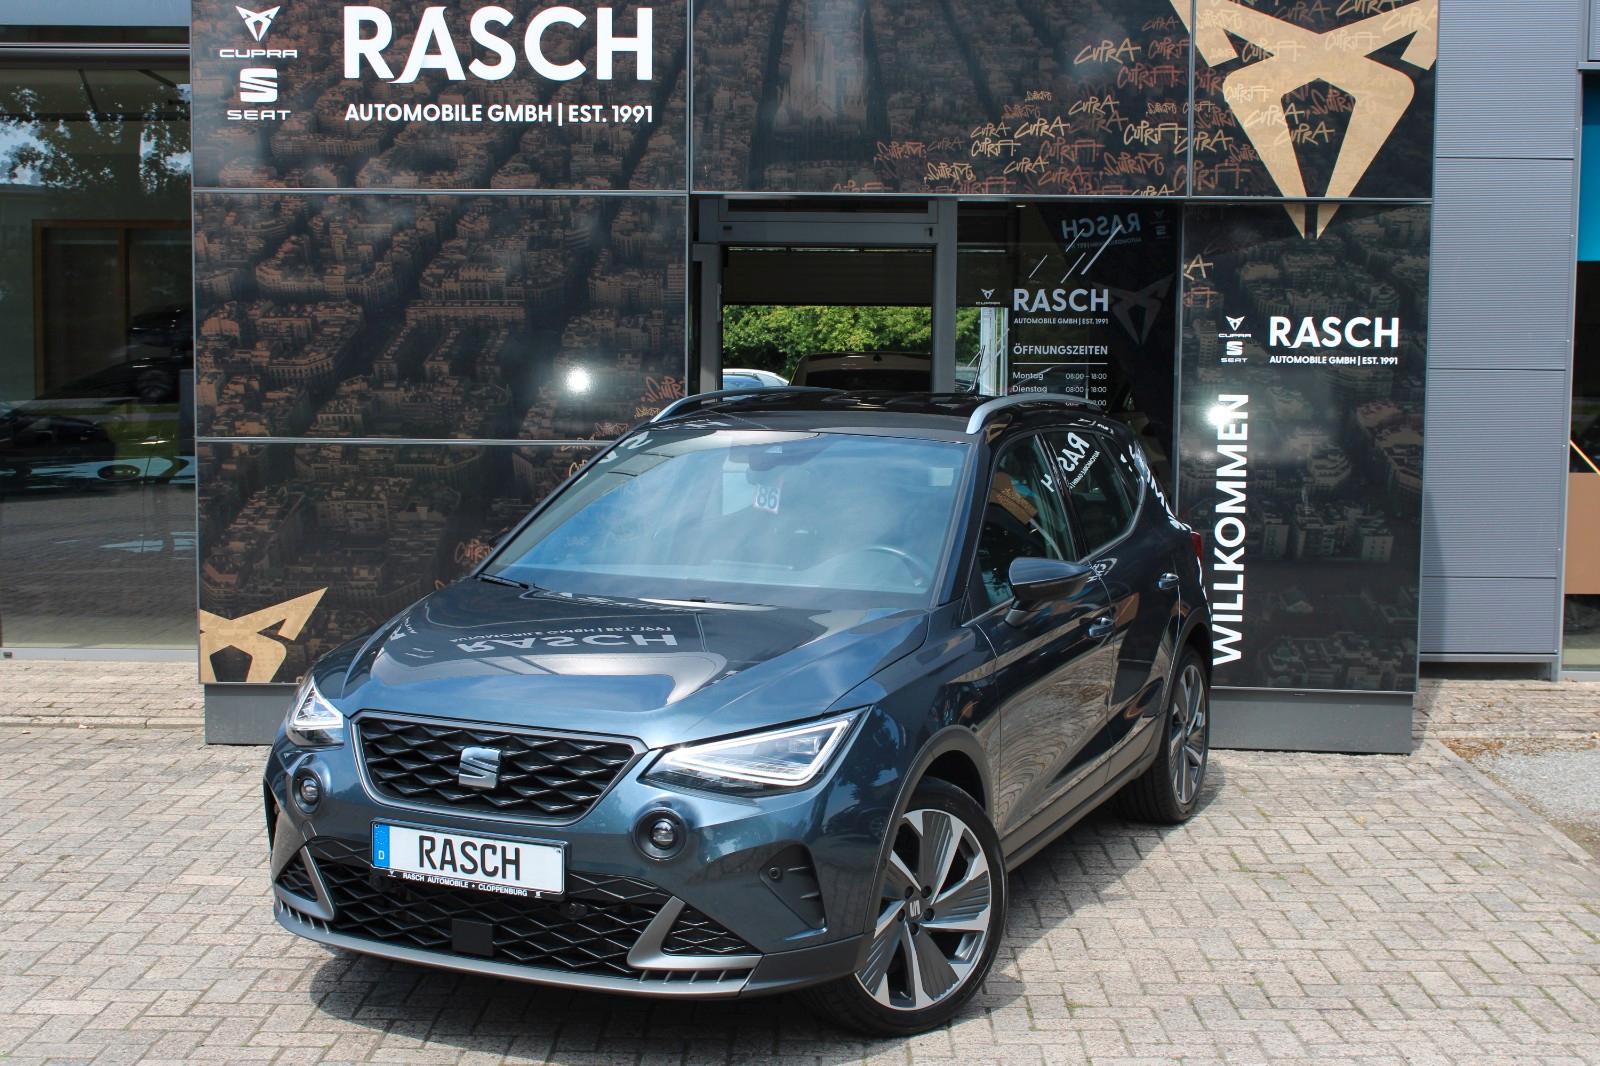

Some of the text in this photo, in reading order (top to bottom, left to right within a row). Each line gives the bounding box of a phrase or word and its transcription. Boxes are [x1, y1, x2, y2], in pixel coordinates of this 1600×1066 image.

[218, 48, 298, 59] CUPRA
[343, 5, 653, 84] RASCH
[1073, 37, 1142, 65] CUPRA
[226, 109, 292, 121] SEAT
[344, 102, 653, 124] AUTOMOBILE GMBH EST. 1991
[1068, 95, 1120, 116] CUPRA
[970, 121, 1011, 138] CUPRA
[1014, 115, 1071, 139] CUPRA
[1002, 154, 1050, 175] CUPRA
[1013, 287, 1109, 313] RASCH
[1013, 317, 1057, 325] AUTOMOBILE
[1269, 315, 1400, 349] RASCH
[1012, 343, 1109, 356] ÖFFNUNGSZEITEN
[1269, 355, 1398, 365] AUTOMOBILE GMBH EST. 1991
[1012, 371, 1044, 381] Montag
[1012, 385, 1048, 394] Dienstag
[757, 487, 779, 509] 86
[1211, 393, 1249, 667] WILLKOMMEN
[378, 850, 385, 860] D
[418, 834, 521, 881] RASCH
[402, 872, 425, 882] RASCH
[427, 875, 469, 889] AUTOMOBILE
[477, 883, 528, 897] CLOPPENBURG
